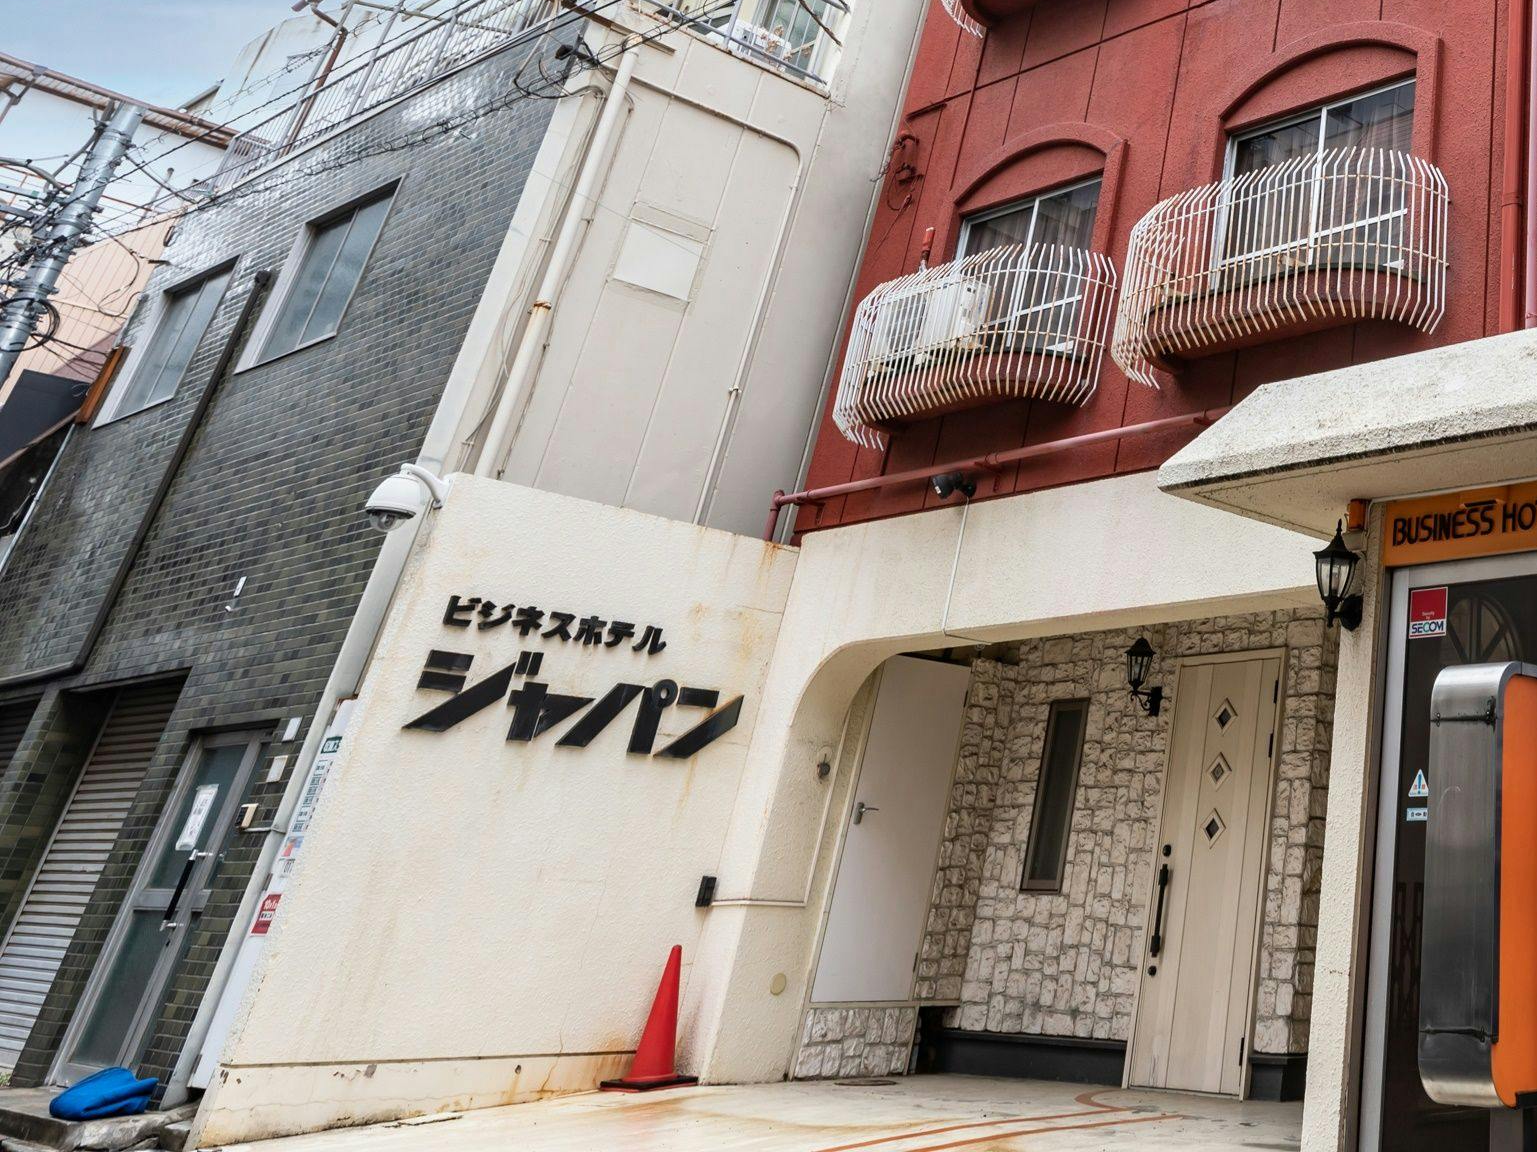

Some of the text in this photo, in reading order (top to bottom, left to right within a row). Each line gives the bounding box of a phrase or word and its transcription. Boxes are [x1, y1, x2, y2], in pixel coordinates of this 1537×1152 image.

[1391, 504, 1495, 547] BUSINESS
[442, 594, 668, 656] ビジネスホテル
[1411, 621, 1444, 634] SECOM
[401, 649, 745, 759] ジャパン
